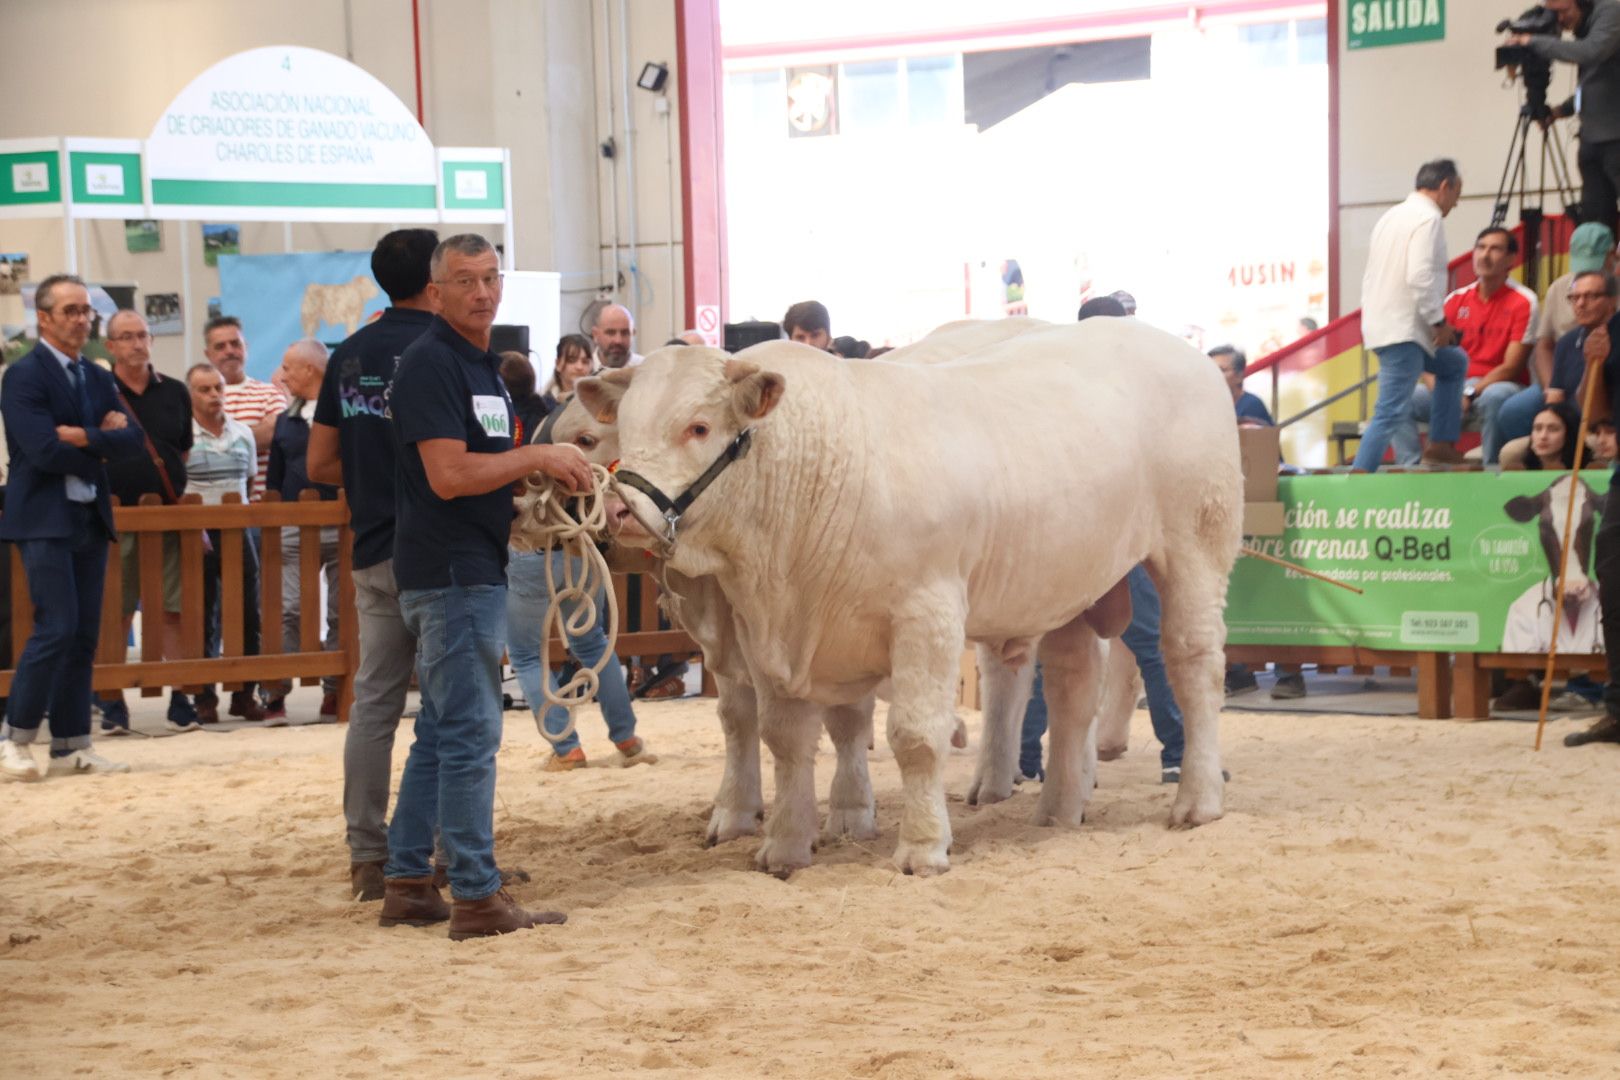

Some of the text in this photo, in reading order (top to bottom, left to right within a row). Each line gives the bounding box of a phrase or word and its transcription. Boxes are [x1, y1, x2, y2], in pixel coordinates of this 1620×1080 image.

[1352, 0, 1440, 34] SALIDA
[281, 55, 292, 71] 4
[210, 90, 375, 117] ASOCIACIÓN NACIONAL
[167, 114, 415, 142] DE CRIADORES DE GANADO VACUNO
[298, 144, 316, 164] DE
[320, 142, 375, 165] ESPAÑA
[341, 394, 385, 418] MAQ
[1285, 500, 1453, 529] ción se realiza
[1243, 535, 1452, 562] bre arenas Q-Bed
[1285, 568, 1360, 580] Reendado
